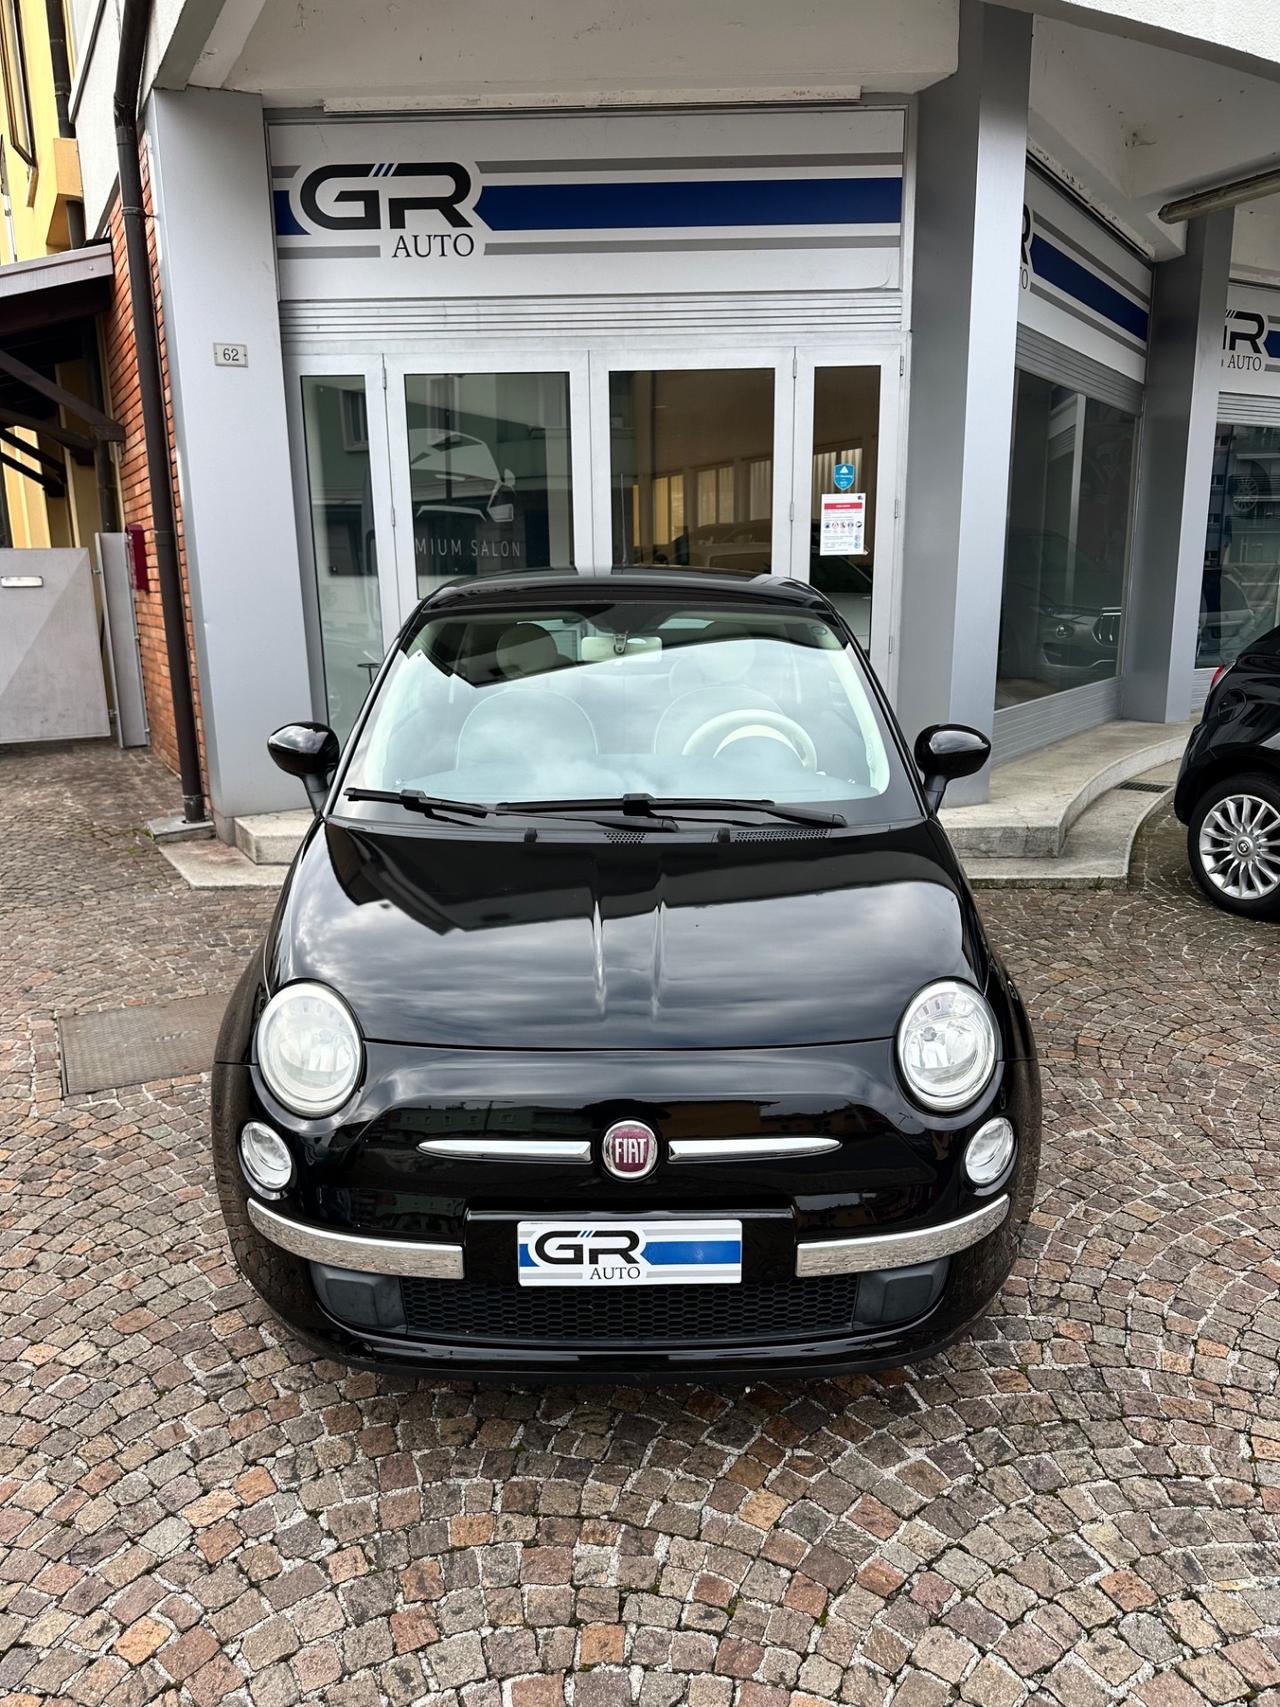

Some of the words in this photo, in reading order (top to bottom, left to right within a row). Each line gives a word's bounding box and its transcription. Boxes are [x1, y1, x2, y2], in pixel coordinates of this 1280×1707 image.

[300, 162, 473, 230] GR
[391, 233, 474, 258] AUTO
[223, 347, 239, 361] 62
[1228, 354, 1262, 371] AUTO
[470, 540, 520, 557] SALON
[615, 1138, 647, 1163] FIAT
[534, 1230, 640, 1265] GR
[589, 1266, 641, 1280] AUTO
